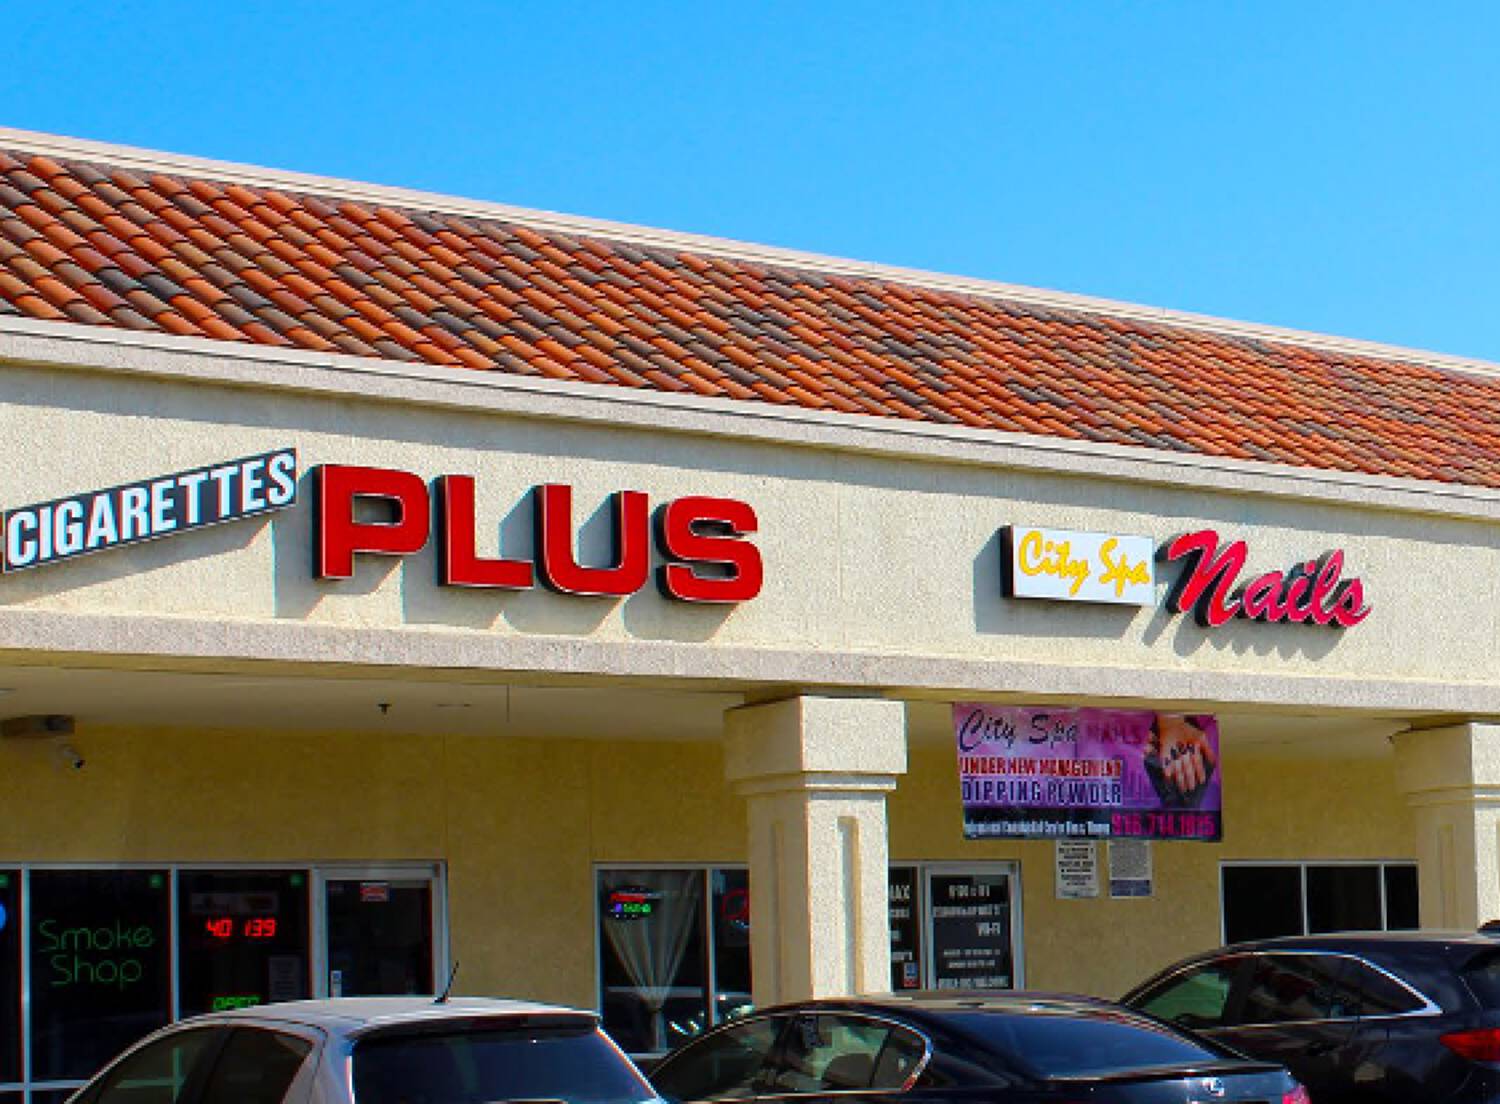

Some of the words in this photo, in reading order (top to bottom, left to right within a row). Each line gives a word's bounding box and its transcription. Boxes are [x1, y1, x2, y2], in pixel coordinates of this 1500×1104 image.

[4, 450, 297, 568] CIGARETTES
[314, 463, 765, 603] PLUS
[1018, 530, 1089, 596] City
[1098, 537, 1151, 598] Spa
[1167, 529, 1373, 627] Nails
[960, 757, 1006, 775] UNDER
[1008, 758, 1036, 775] NEW
[961, 780, 1041, 802] DIPPING
[1047, 782, 1122, 804] POWDER
[38, 919, 154, 952] Smoke
[50, 954, 143, 991] Shop
